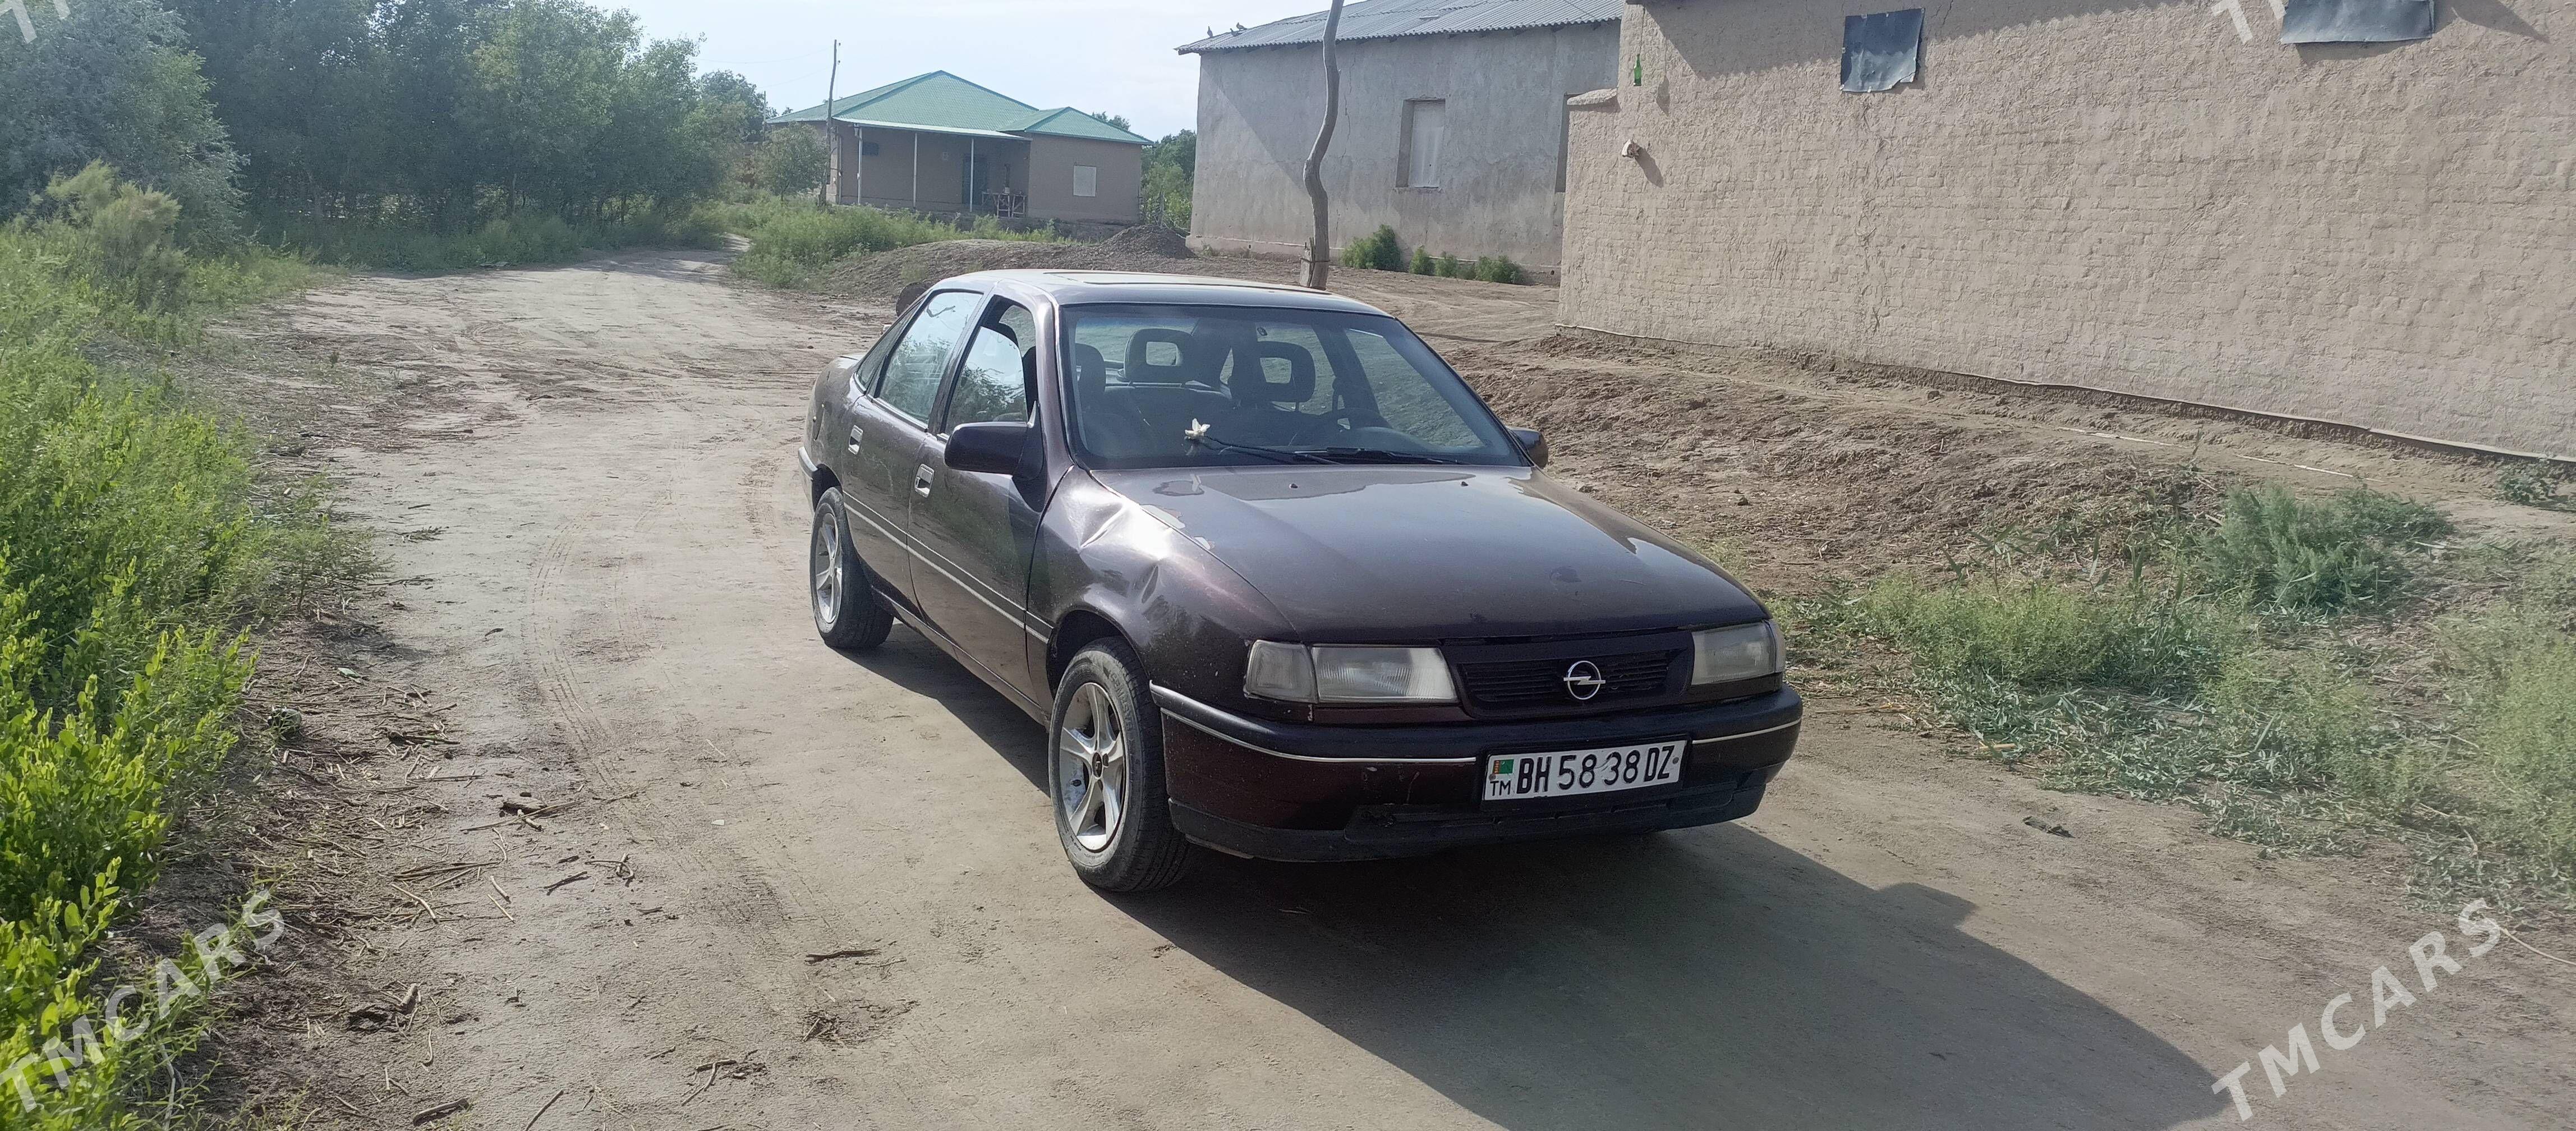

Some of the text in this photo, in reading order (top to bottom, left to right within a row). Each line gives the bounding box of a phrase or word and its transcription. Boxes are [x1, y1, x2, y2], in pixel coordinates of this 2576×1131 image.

[1516, 757, 1552, 794] BH
[1558, 753, 1598, 790] 58
[1644, 746, 1675, 781] DZ
[1490, 780, 1511, 796] TM
